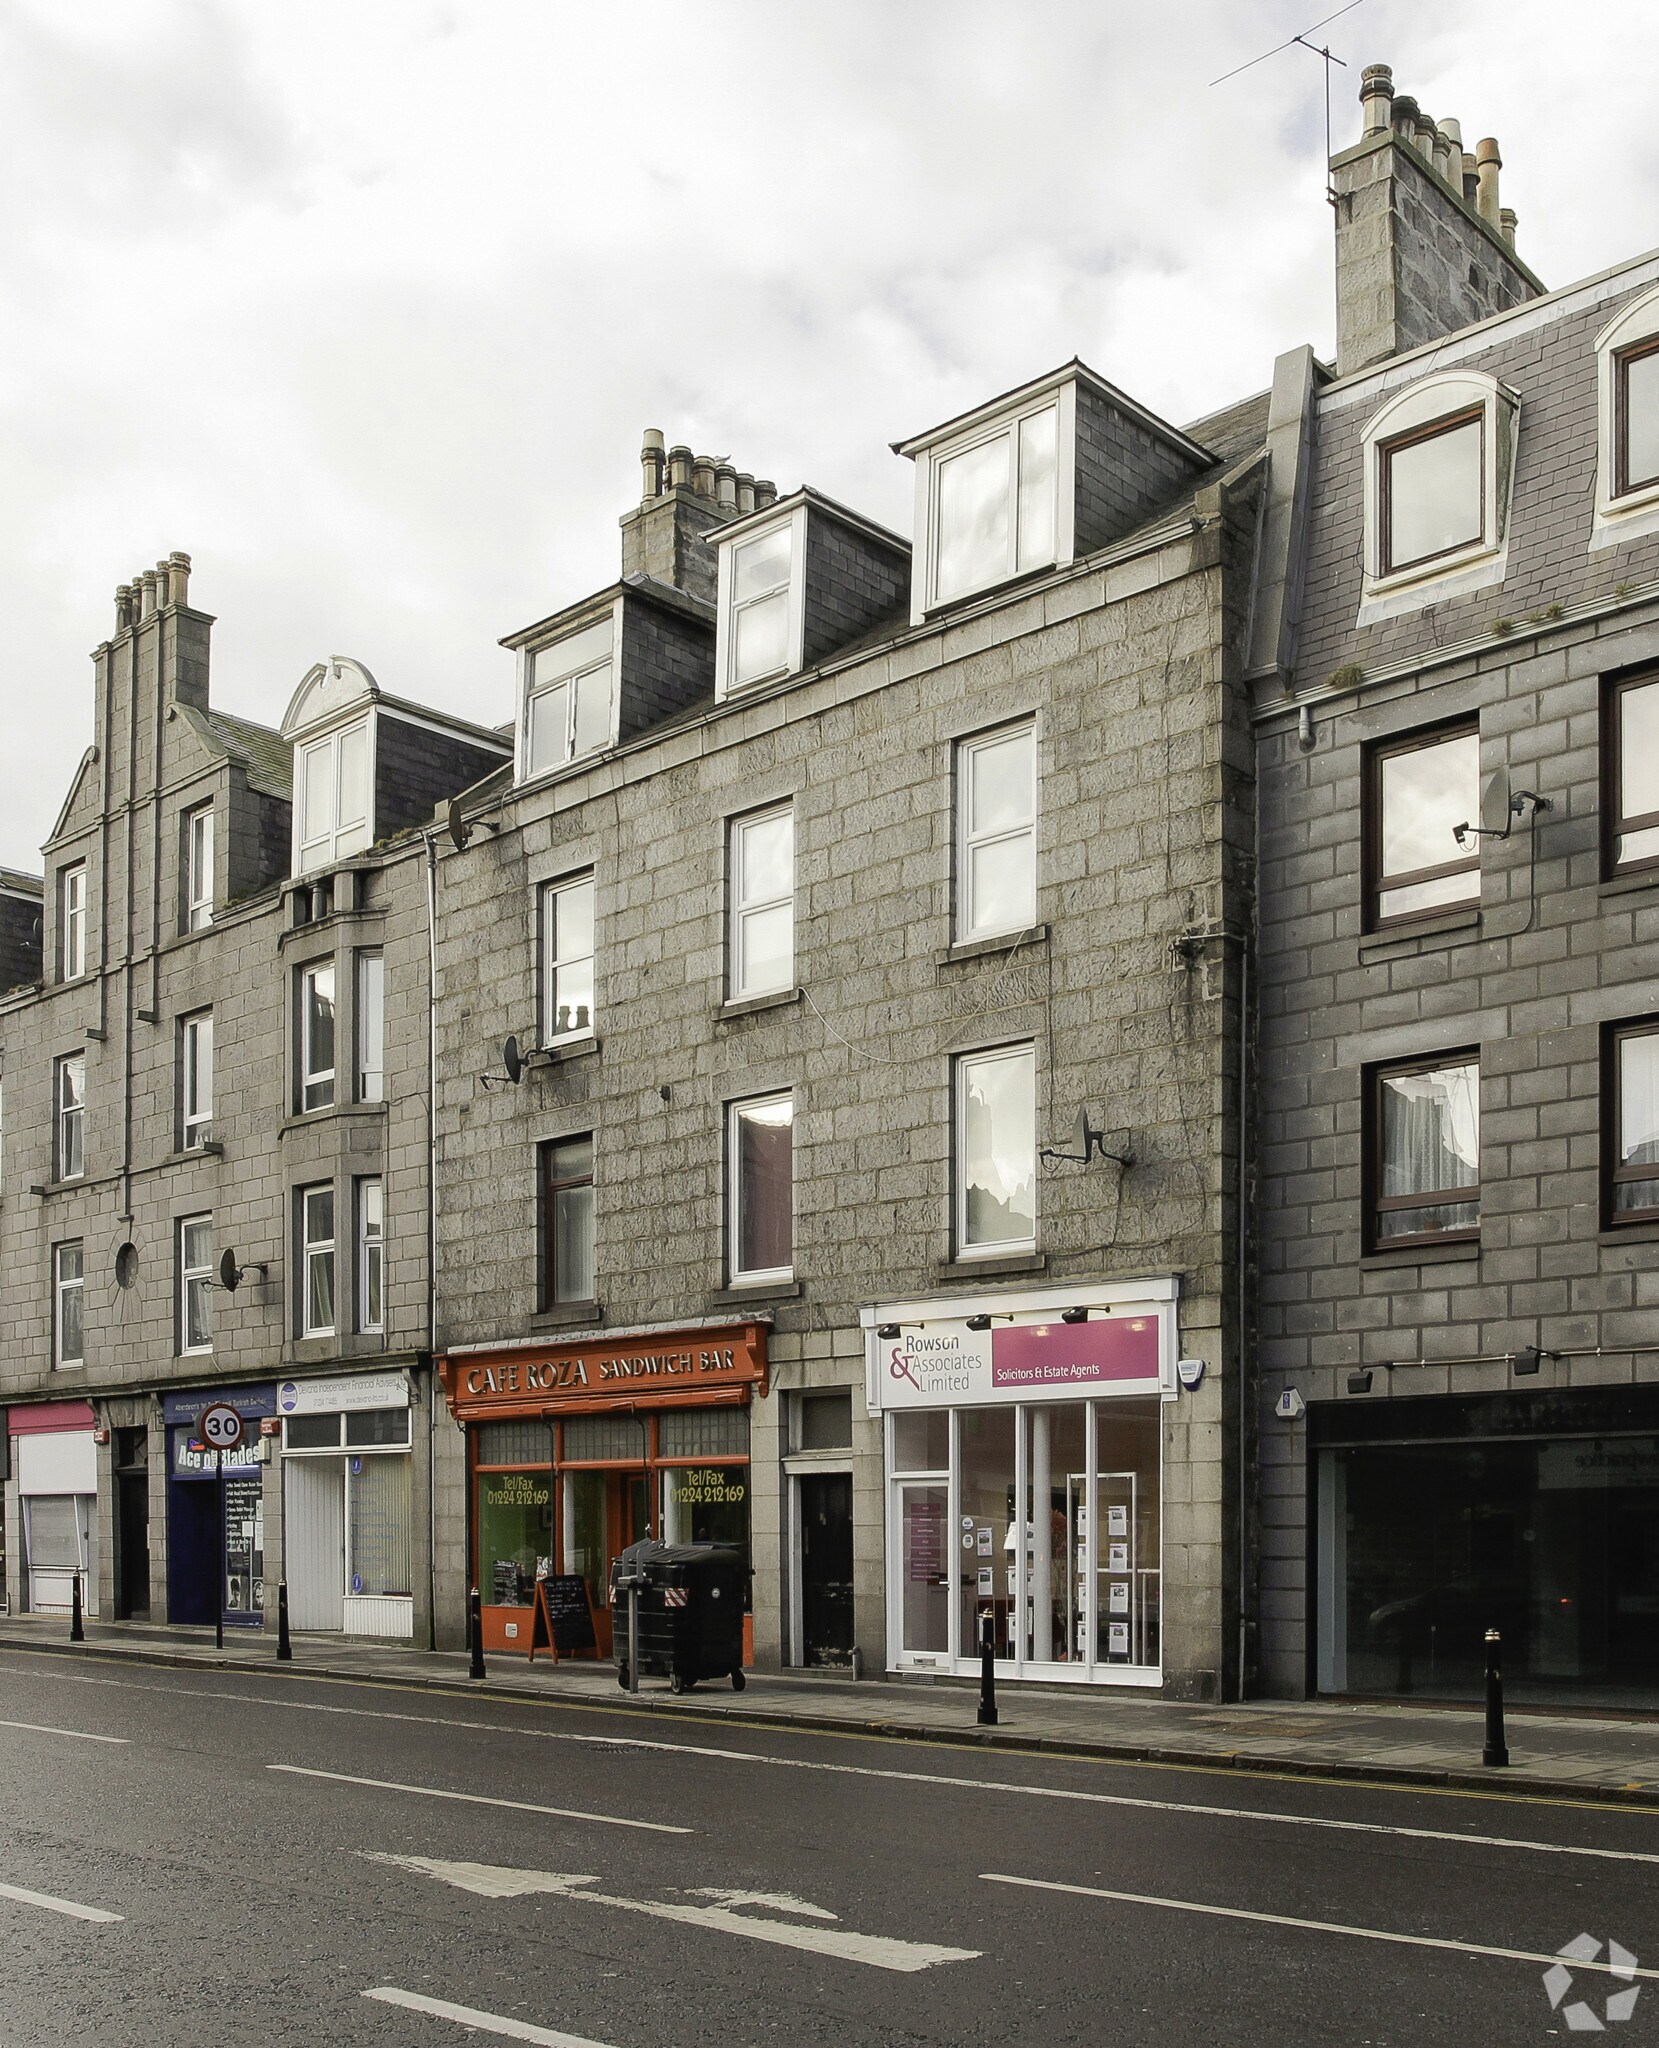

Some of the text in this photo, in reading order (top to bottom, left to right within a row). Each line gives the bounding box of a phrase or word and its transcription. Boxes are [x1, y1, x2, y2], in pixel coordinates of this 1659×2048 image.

[906, 1335, 959, 1353] Rowson
[467, 1349, 735, 1394] CAFE ROZA SANDWICH BAR
[890, 1347, 982, 1391] & Associates
[997, 1367, 1033, 1381] Solicitors
[1044, 1365, 1069, 1378] Estate
[1070, 1363, 1100, 1379] Agents
[919, 1372, 970, 1392] Limited
[207, 1417, 239, 1436] 30
[178, 1444, 201, 1468] Ace
[503, 1476, 534, 1491] Tel/Fax
[687, 1470, 725, 1486] Tel/Fax
[487, 1490, 549, 1505] 01224 212169
[670, 1486, 744, 1503] 01224 212169
